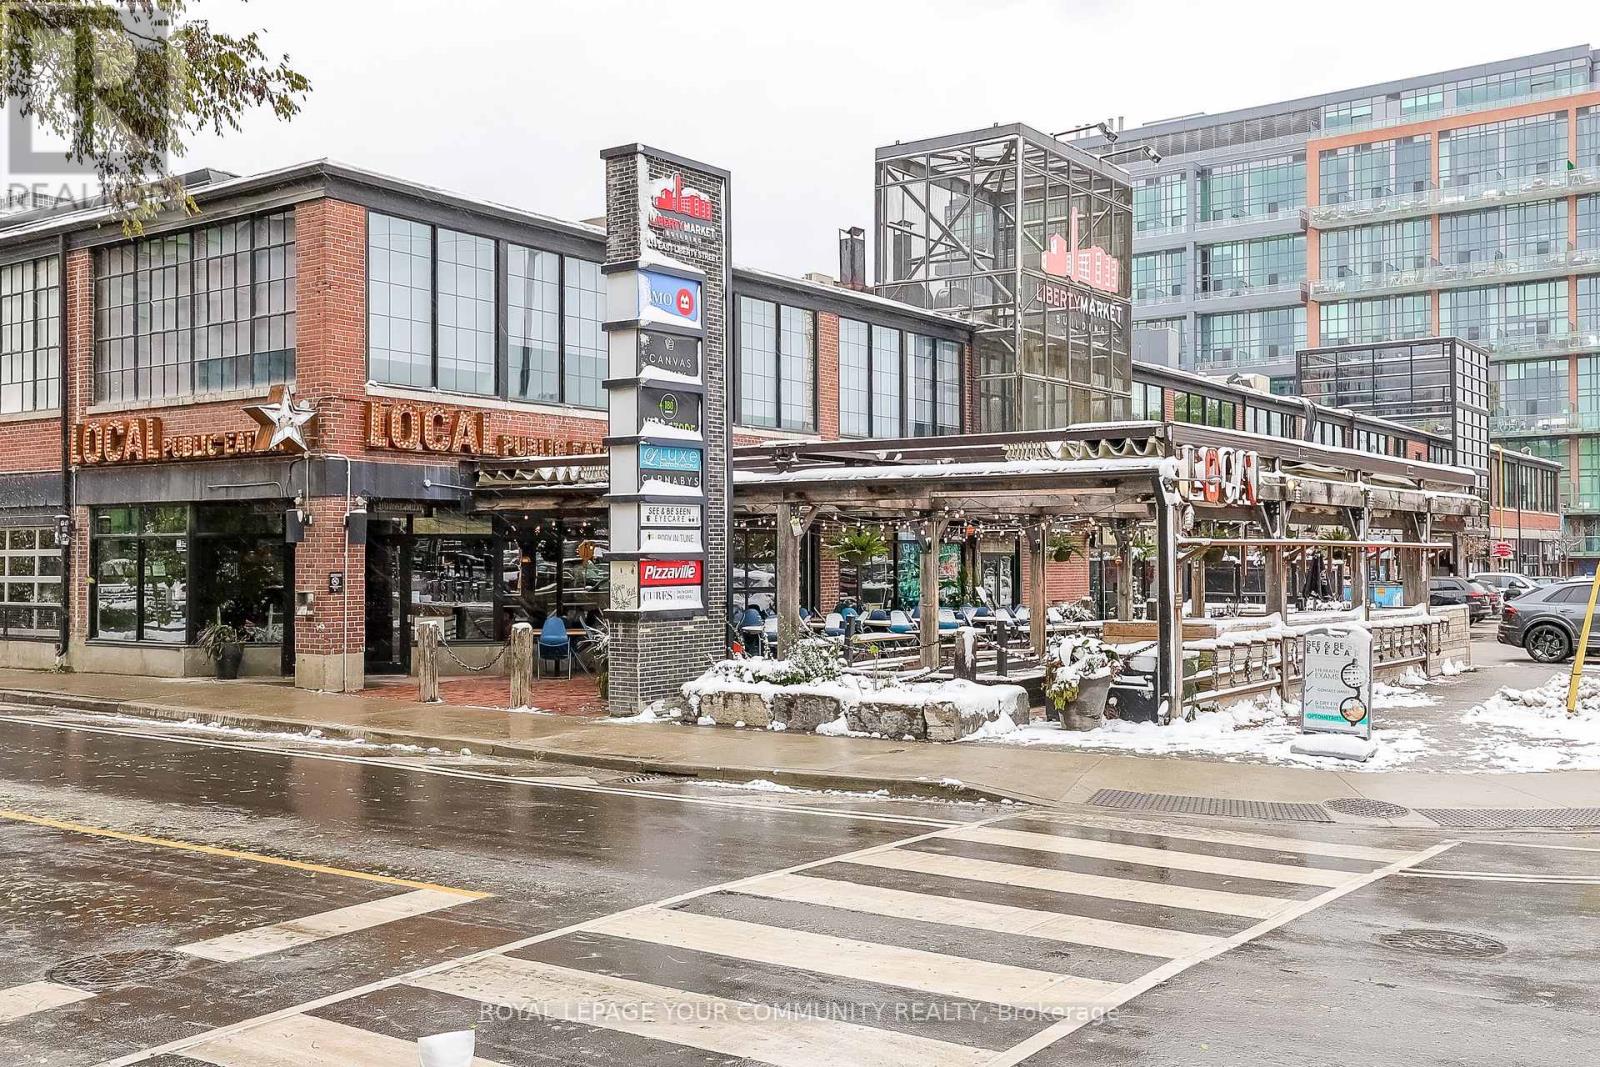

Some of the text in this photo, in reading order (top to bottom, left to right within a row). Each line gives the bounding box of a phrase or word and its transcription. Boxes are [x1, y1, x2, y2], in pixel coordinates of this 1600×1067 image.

[650, 290, 673, 306] MO
[649, 353, 692, 368] CANVAS
[364, 401, 498, 454] LOCAL
[499, 435, 567, 457] PUBLIC
[69, 416, 162, 465] LOCAL
[162, 433, 217, 457] PUBLIC
[648, 507, 692, 516] SEE & BE SEEN
[644, 564, 696, 579] Pizzaville
[1306, 640, 1321, 649] SEE
[1324, 641, 1330, 650] &
[1333, 642, 1345, 650] BE
[1306, 647, 1350, 656] EYECA
[1314, 671, 1339, 681] EXAMS
